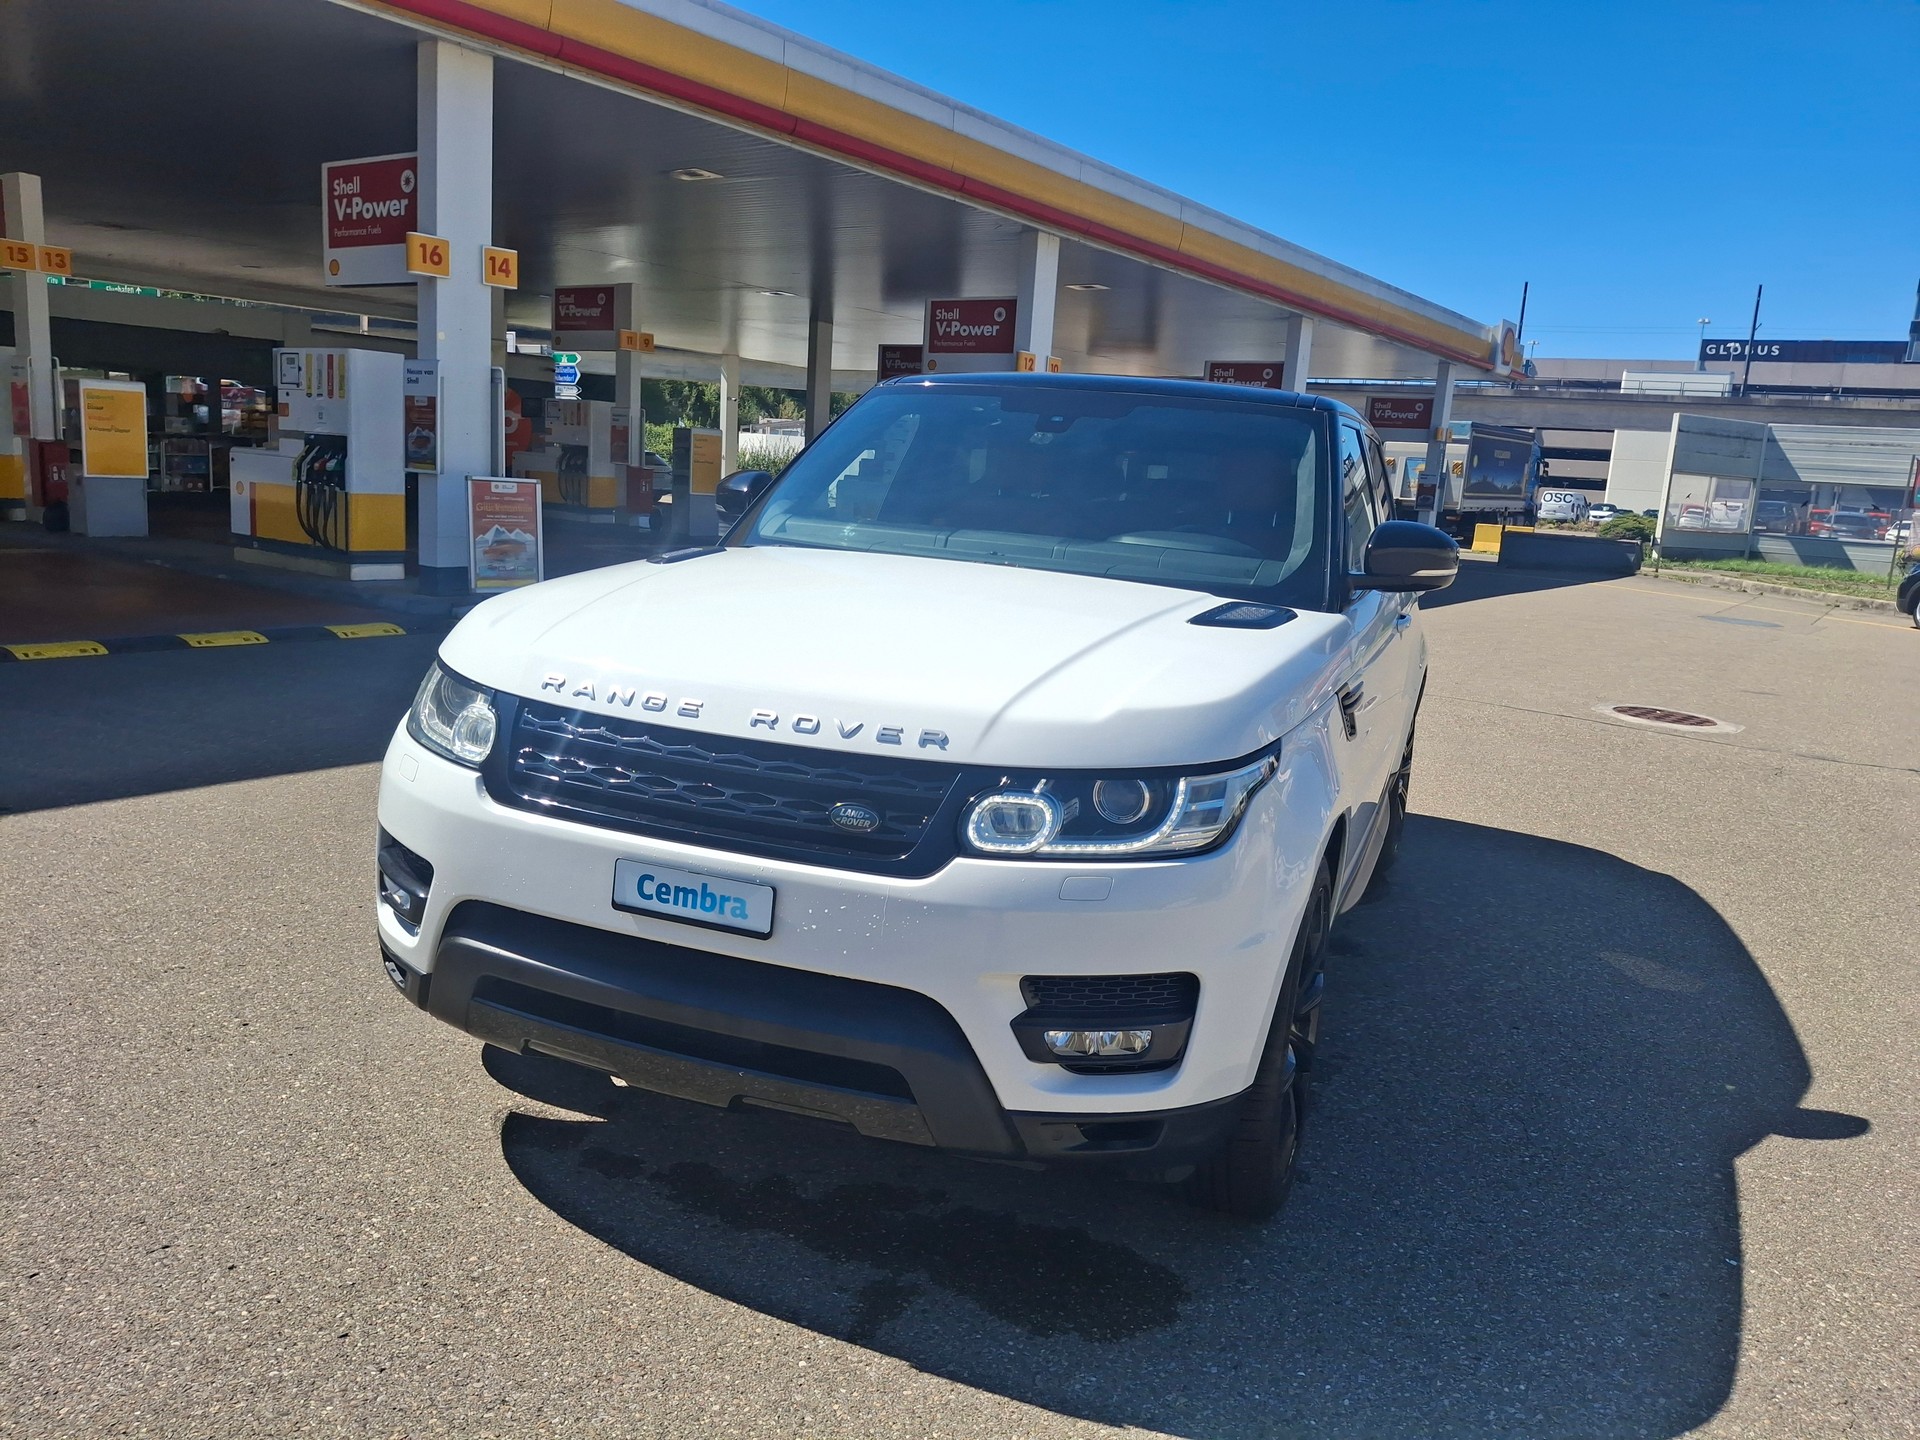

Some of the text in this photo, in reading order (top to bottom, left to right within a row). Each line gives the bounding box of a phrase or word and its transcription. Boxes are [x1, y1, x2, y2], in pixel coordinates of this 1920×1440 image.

[333, 176, 360, 196] Shell
[334, 197, 409, 222] V-Power
[334, 225, 382, 238] Performance Fuels
[6, 246, 29, 263] 15
[45, 252, 67, 269] 13
[419, 243, 443, 266] 16
[489, 256, 512, 278] 14
[559, 304, 602, 317] V-Power
[935, 308, 960, 320] Shell
[935, 320, 1000, 337] V-Power
[643, 338, 651, 348] 9
[885, 359, 921, 369] V-Powe
[1024, 356, 1034, 372] 12
[1213, 368, 1235, 377] Shell
[1373, 409, 1419, 420] V-Power
[1543, 492, 1573, 503] OSC
[541, 672, 951, 752] RANGE ROVER
[839, 808, 865, 819] LAND
[840, 816, 871, 828] ROVER
[636, 873, 749, 920] Cembra
